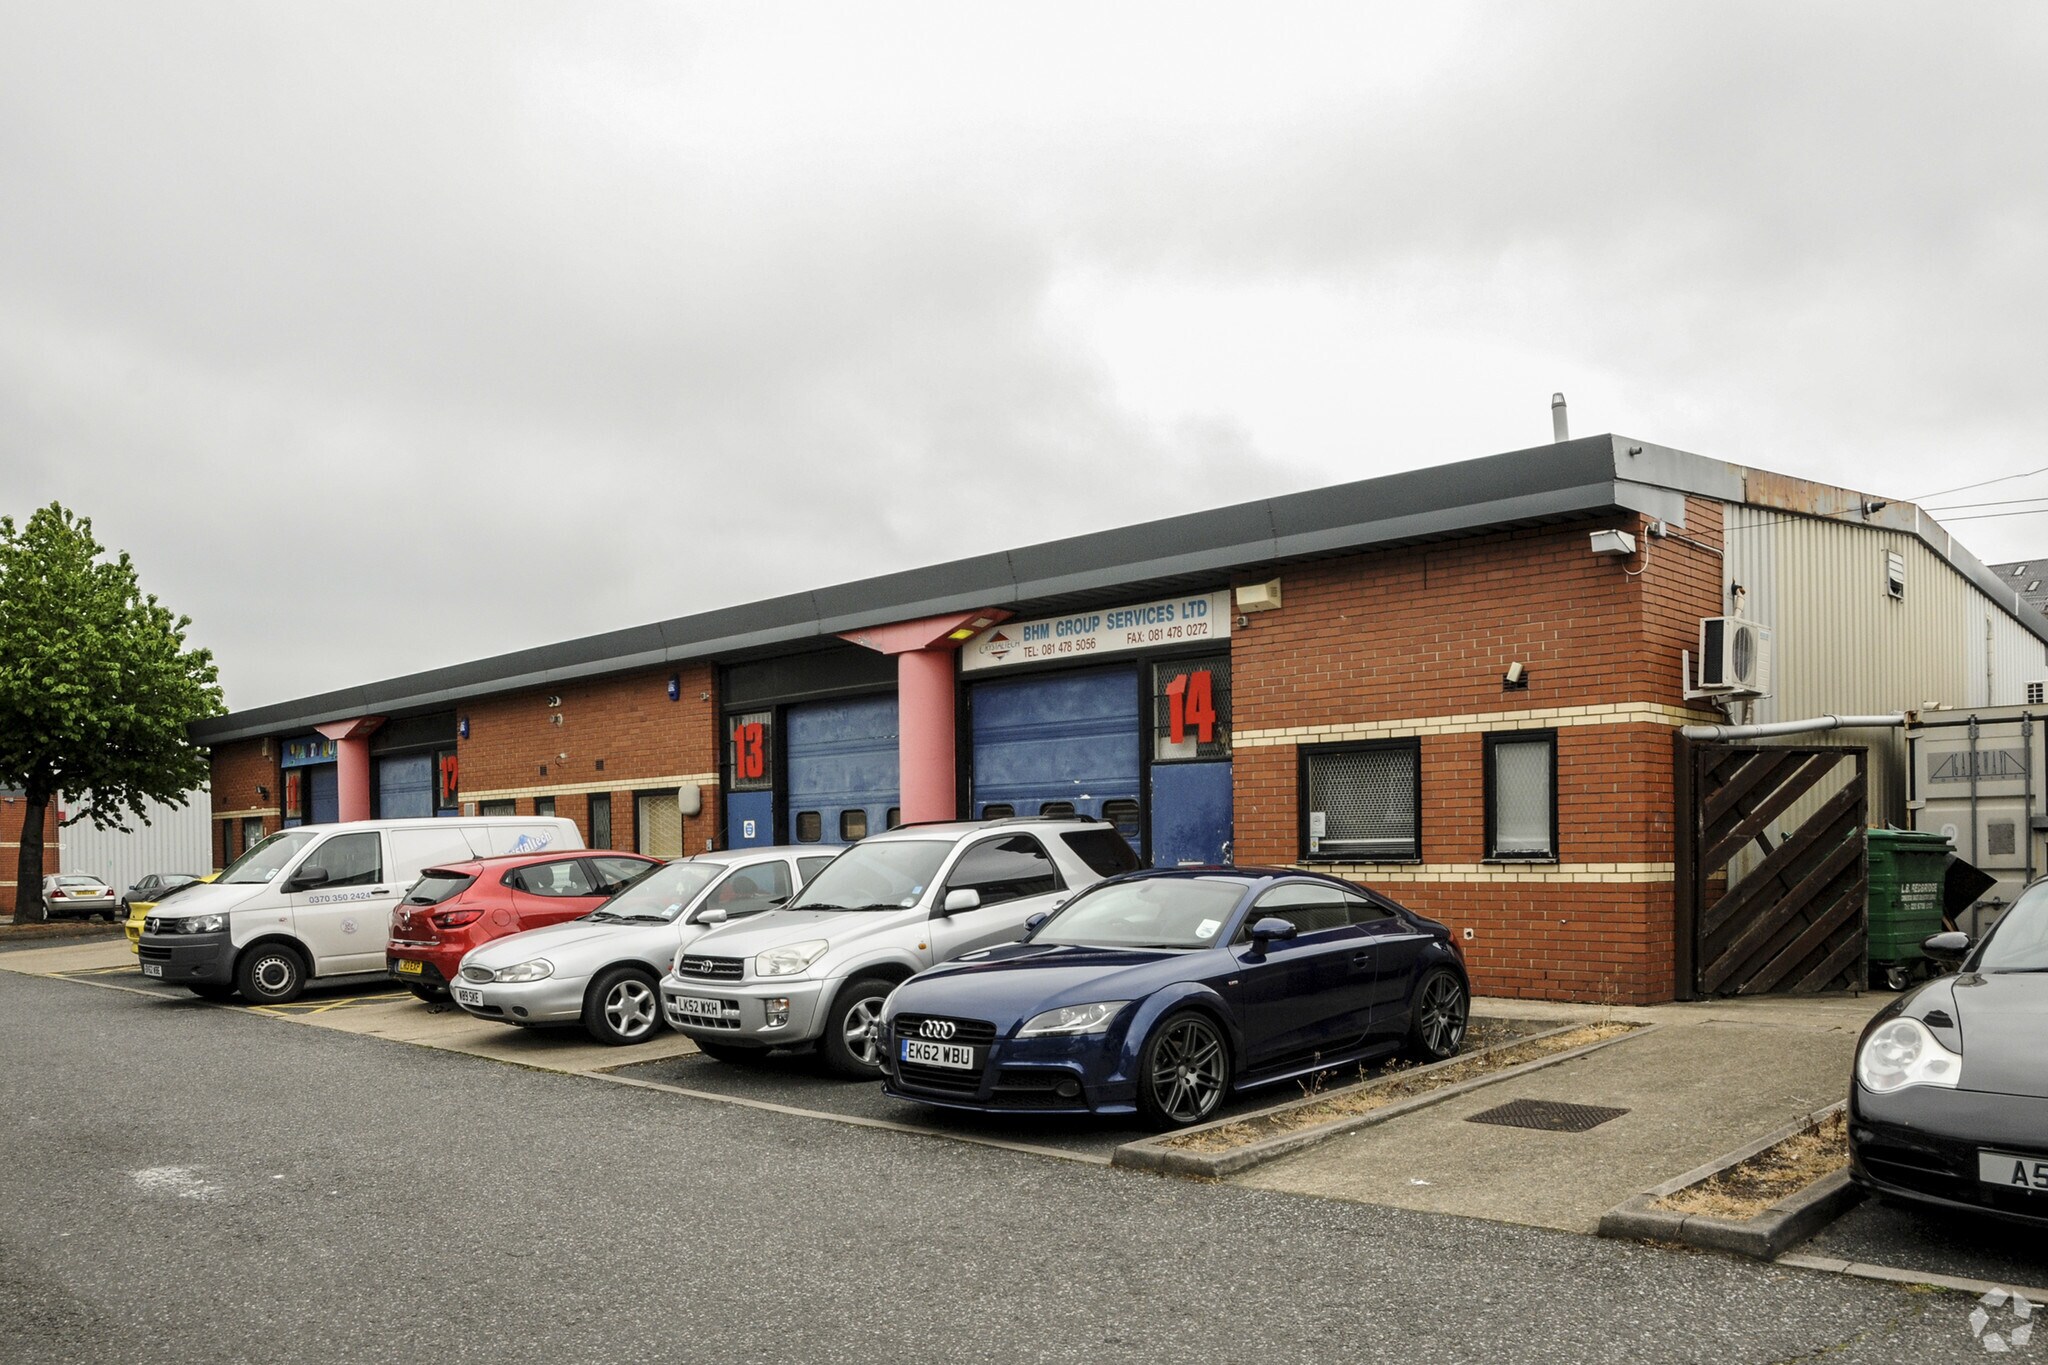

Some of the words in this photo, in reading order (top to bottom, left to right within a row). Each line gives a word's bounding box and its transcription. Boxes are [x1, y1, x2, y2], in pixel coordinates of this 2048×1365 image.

[1023, 622, 1050, 641] BHM
[1056, 615, 1100, 637] GROUP
[1107, 603, 1175, 630] SERVICES
[1182, 599, 1208, 619] LTD
[1127, 631, 1145, 644] FAX:
[1148, 628, 1164, 642] 081
[1167, 625, 1183, 638] 478
[1186, 622, 1208, 636] 0272
[1023, 646, 1039, 658] TEL:
[1042, 643, 1056, 656] 081
[1059, 640, 1073, 653] 478
[1076, 637, 1096, 650] 5056
[1166, 670, 1216, 744] 14
[733, 722, 764, 779] 13
[309, 895, 330, 904] 0370
[332, 893, 349, 902] 350
[350, 892, 371, 900] 2424
[678, 998, 699, 1013] LK52
[700, 1000, 718, 1016] WXH
[908, 1043, 939, 1061] EK62
[943, 1046, 970, 1065] WBU
